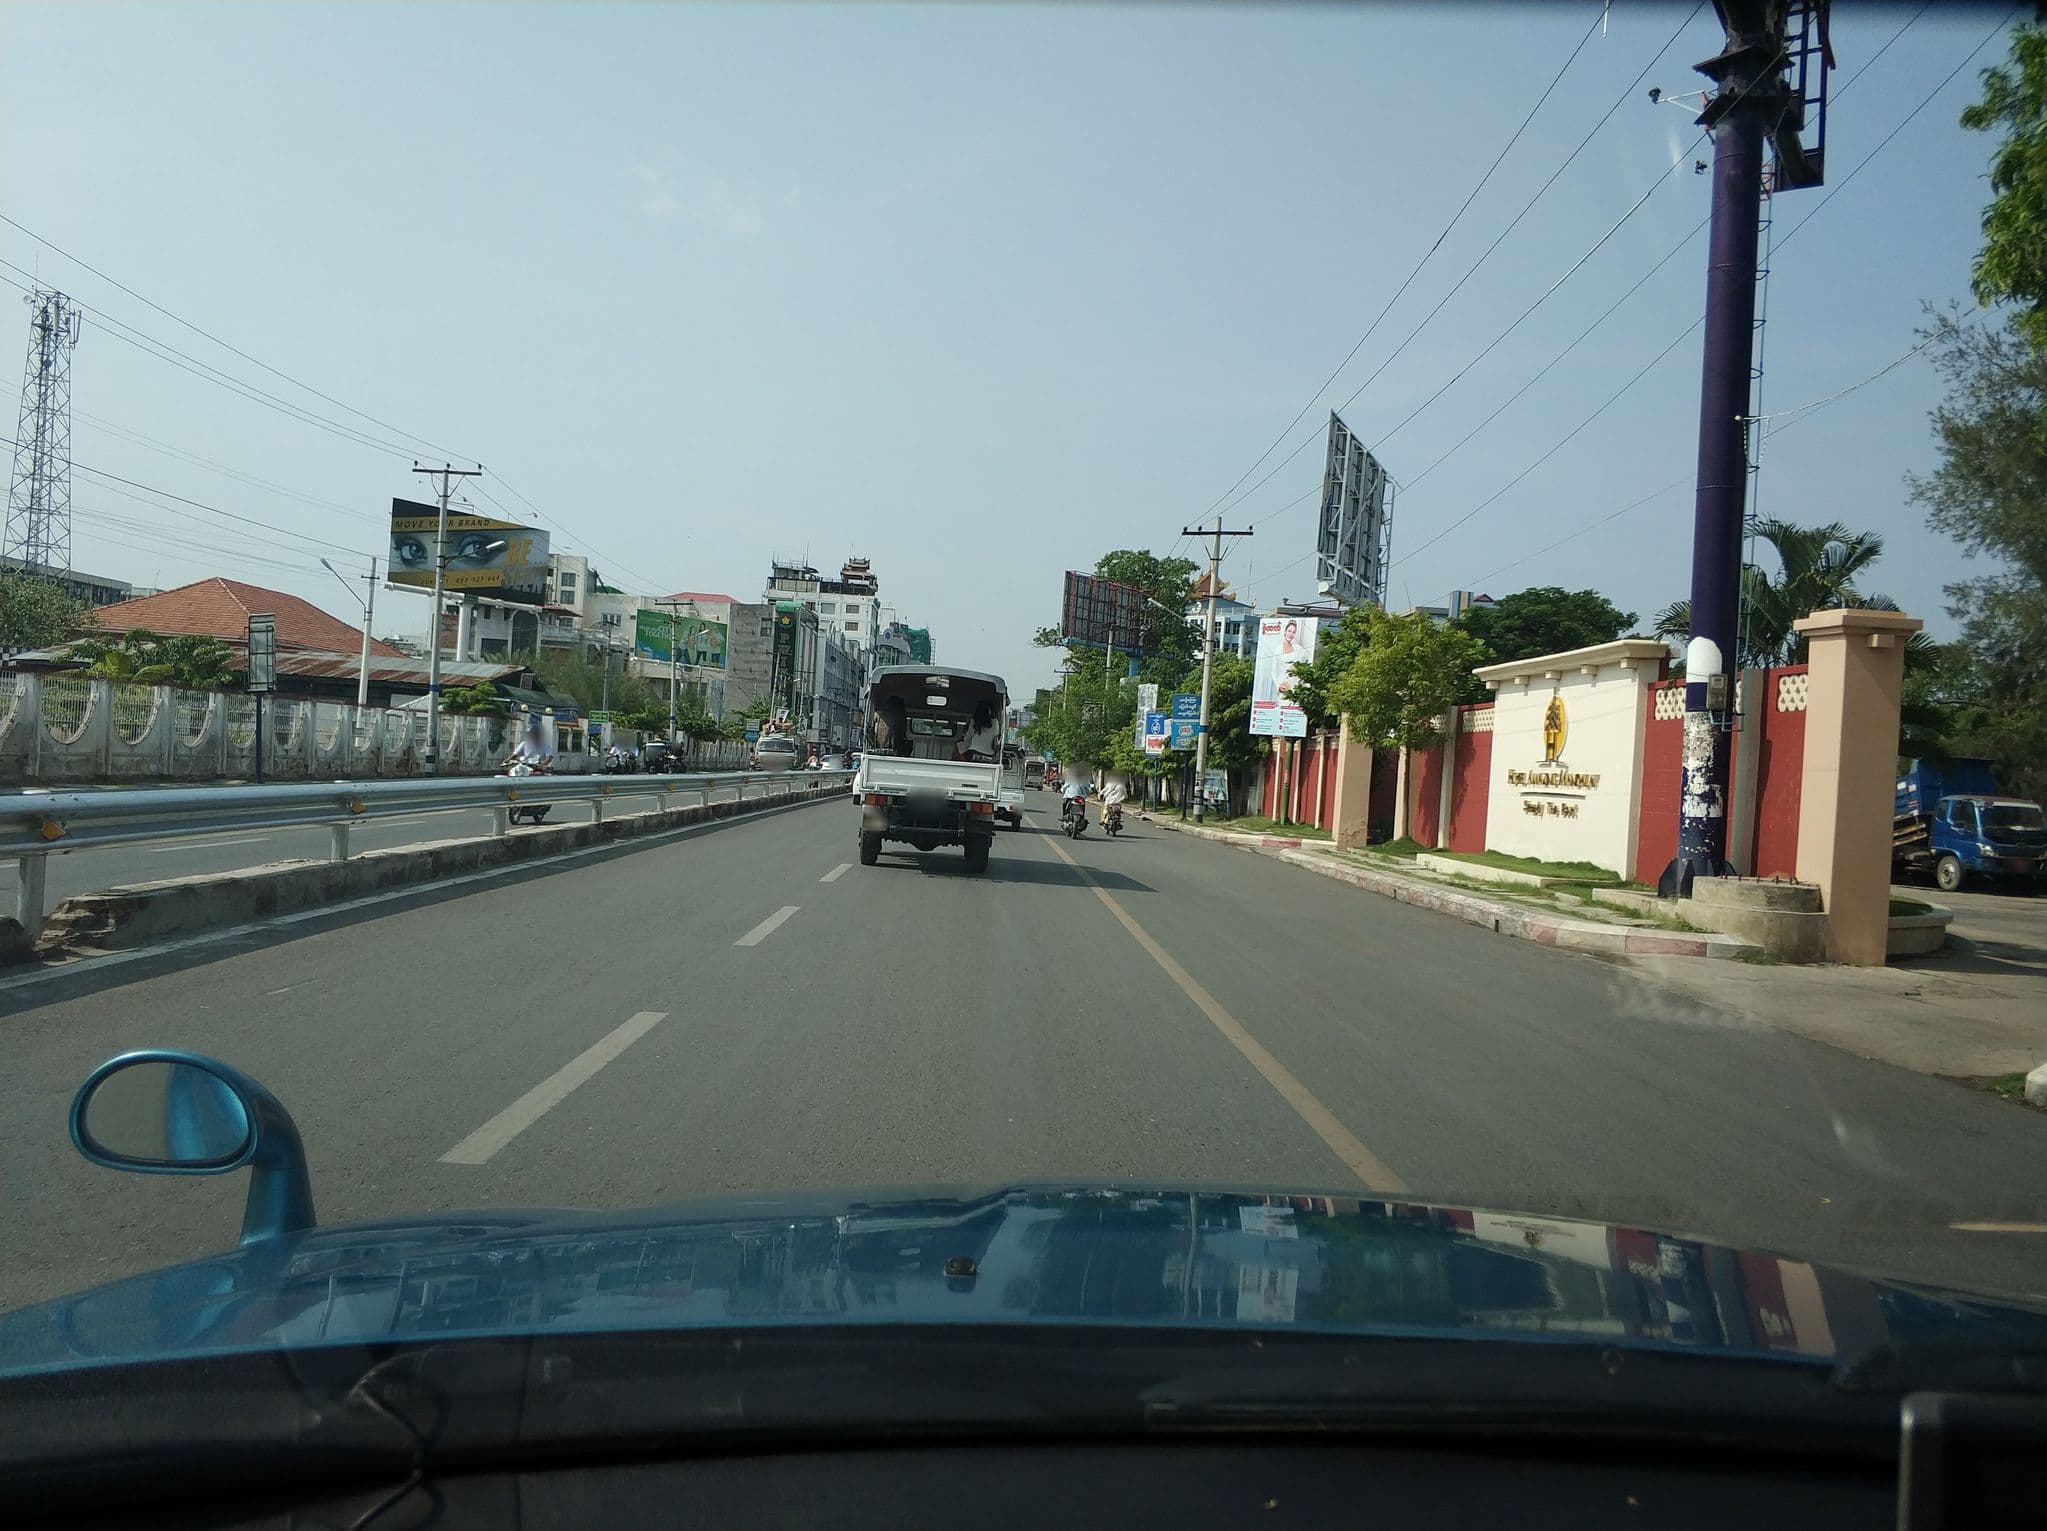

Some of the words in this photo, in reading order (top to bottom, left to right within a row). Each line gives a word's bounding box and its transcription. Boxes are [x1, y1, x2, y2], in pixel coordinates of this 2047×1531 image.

[395, 520, 424, 529] MOVE
[428, 519, 456, 528] YOR
[458, 518, 490, 527] BRAND
